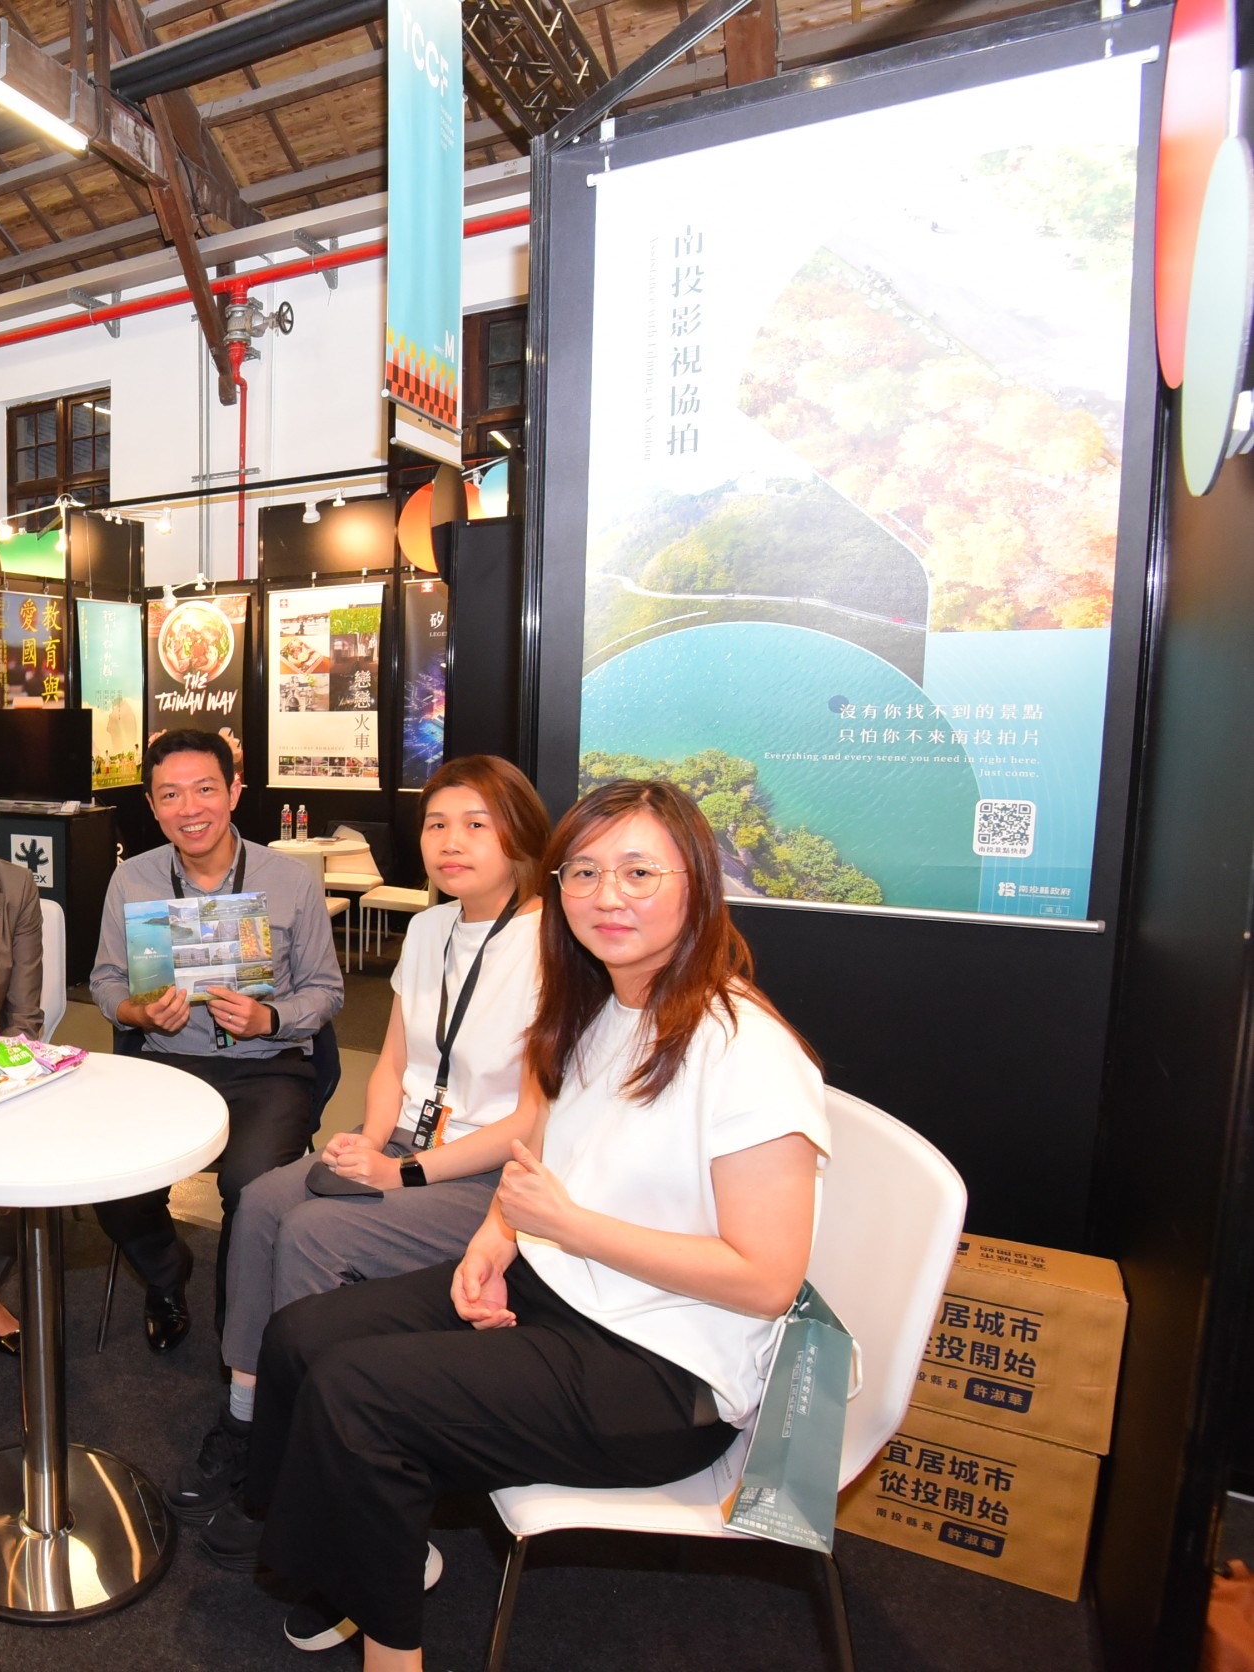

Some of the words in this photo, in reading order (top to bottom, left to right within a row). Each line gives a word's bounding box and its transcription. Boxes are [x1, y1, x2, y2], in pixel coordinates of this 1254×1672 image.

[398, 1, 448, 97] TCCF
[666, 225, 704, 456] 南投影視協拍
[429, 611, 445, 629] 矽
[20, 598, 38, 668] 愛國
[41, 600, 64, 704] 教育與
[183, 671, 208, 690] THE
[206, 688, 238, 715] WAY
[354, 670, 371, 751] 戀戀火車
[839, 703, 1043, 721] 沒有你找不到的景點
[838, 728, 1040, 746] 只怕你不來南投拍片
[764, 752, 818, 763] Everything
[822, 753, 841, 762] and
[845, 754, 873, 764] every
[876, 755, 907, 763] scene
[910, 756, 930, 765] you
[933, 755, 959, 763] need
[979, 756, 1007, 767] right
[1011, 757, 1041, 765] here.
[979, 768, 1002, 778] Just
[1005, 770, 1040, 779] come.
[979, 846, 1027, 854] 南投景點快搜
[34, 874, 46, 883] ex
[1019, 885, 1071, 896] 南投縣政府
[973, 1383, 1023, 1406] 許淑華
[883, 1440, 1015, 1492] 宜居城市
[879, 1468, 1010, 1526] 從投開始
[876, 1507, 933, 1531] 南投縣長
[947, 1528, 996, 1552] 許淑華
